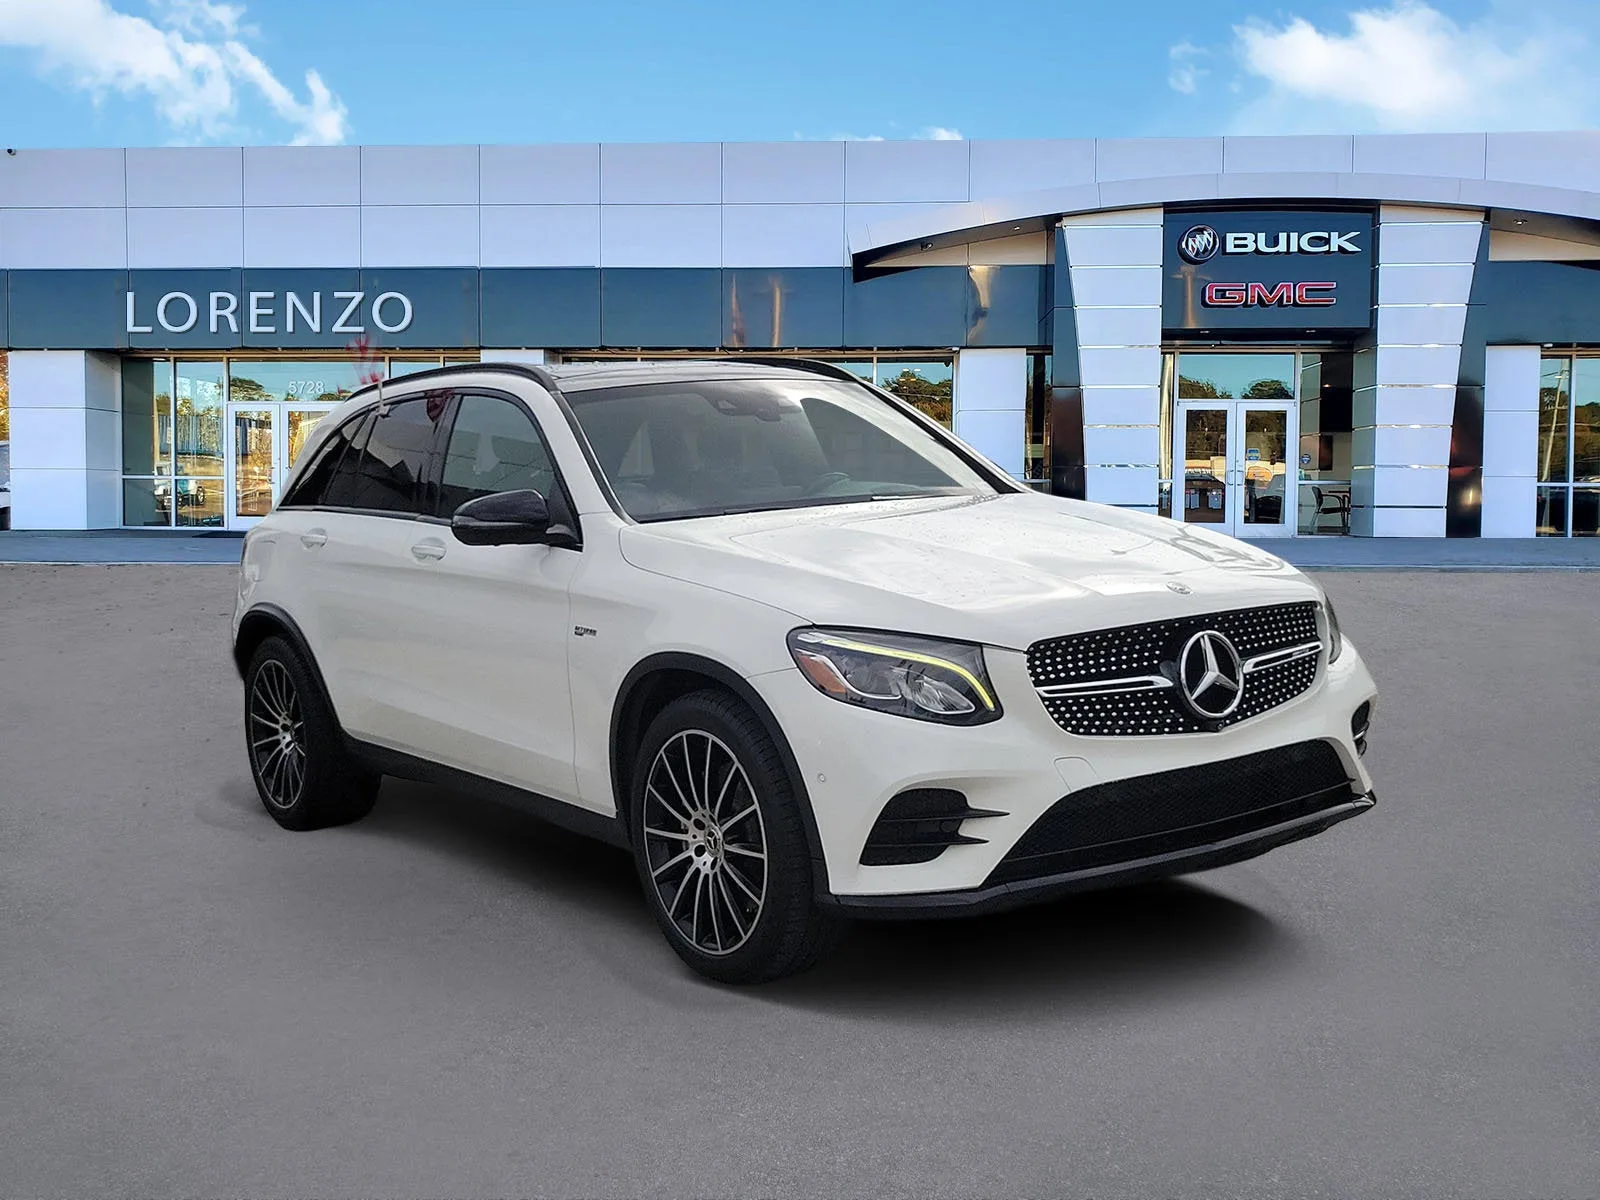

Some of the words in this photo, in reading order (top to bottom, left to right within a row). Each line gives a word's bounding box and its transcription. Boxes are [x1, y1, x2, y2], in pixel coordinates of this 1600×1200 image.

[1225, 231, 1361, 253] BUICK
[1204, 281, 1337, 306] GMC
[126, 291, 413, 333] LORENZO
[288, 380, 325, 394] 5728
